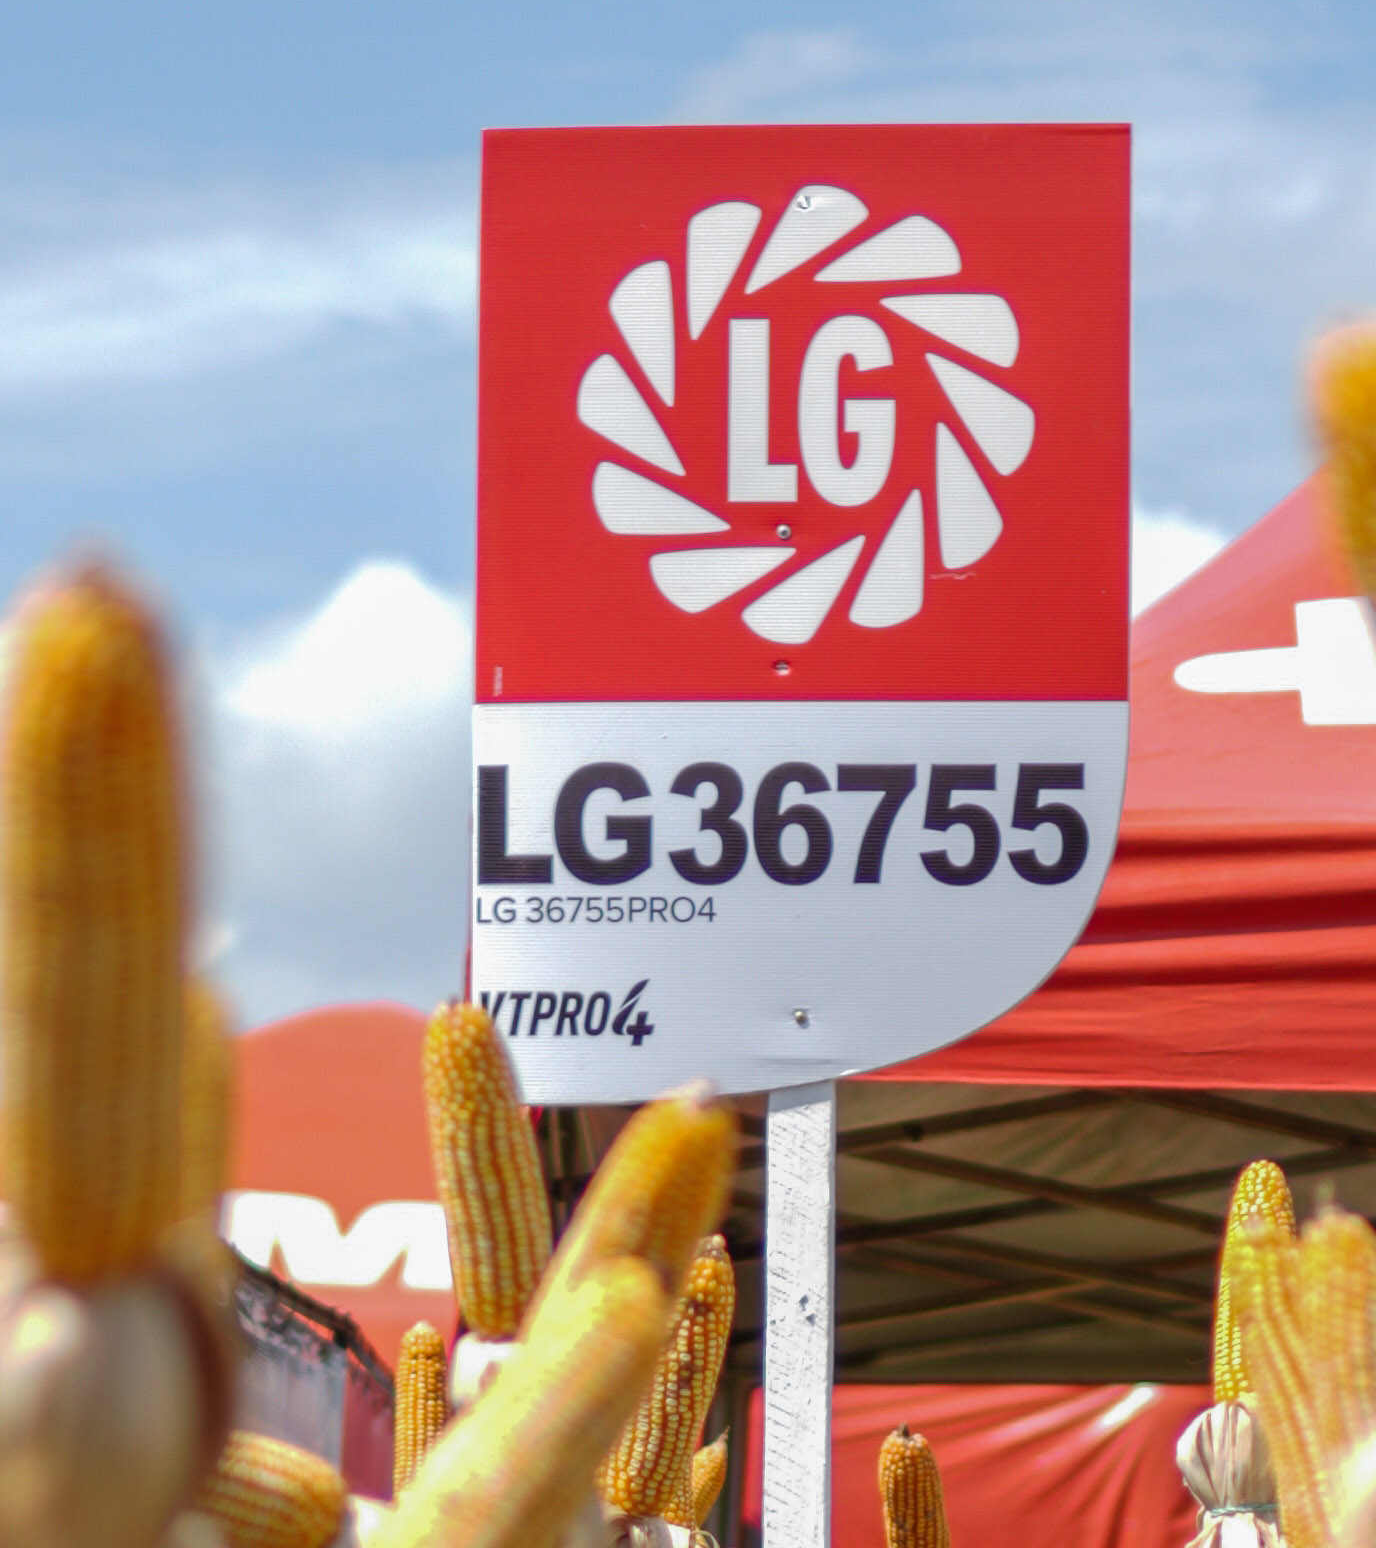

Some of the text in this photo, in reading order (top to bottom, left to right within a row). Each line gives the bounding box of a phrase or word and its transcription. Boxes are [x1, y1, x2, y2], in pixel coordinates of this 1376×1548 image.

[727, 314, 896, 507] LG
[477, 761, 1089, 886] LG36755
[476, 896, 717, 924] LG 36755PRO4
